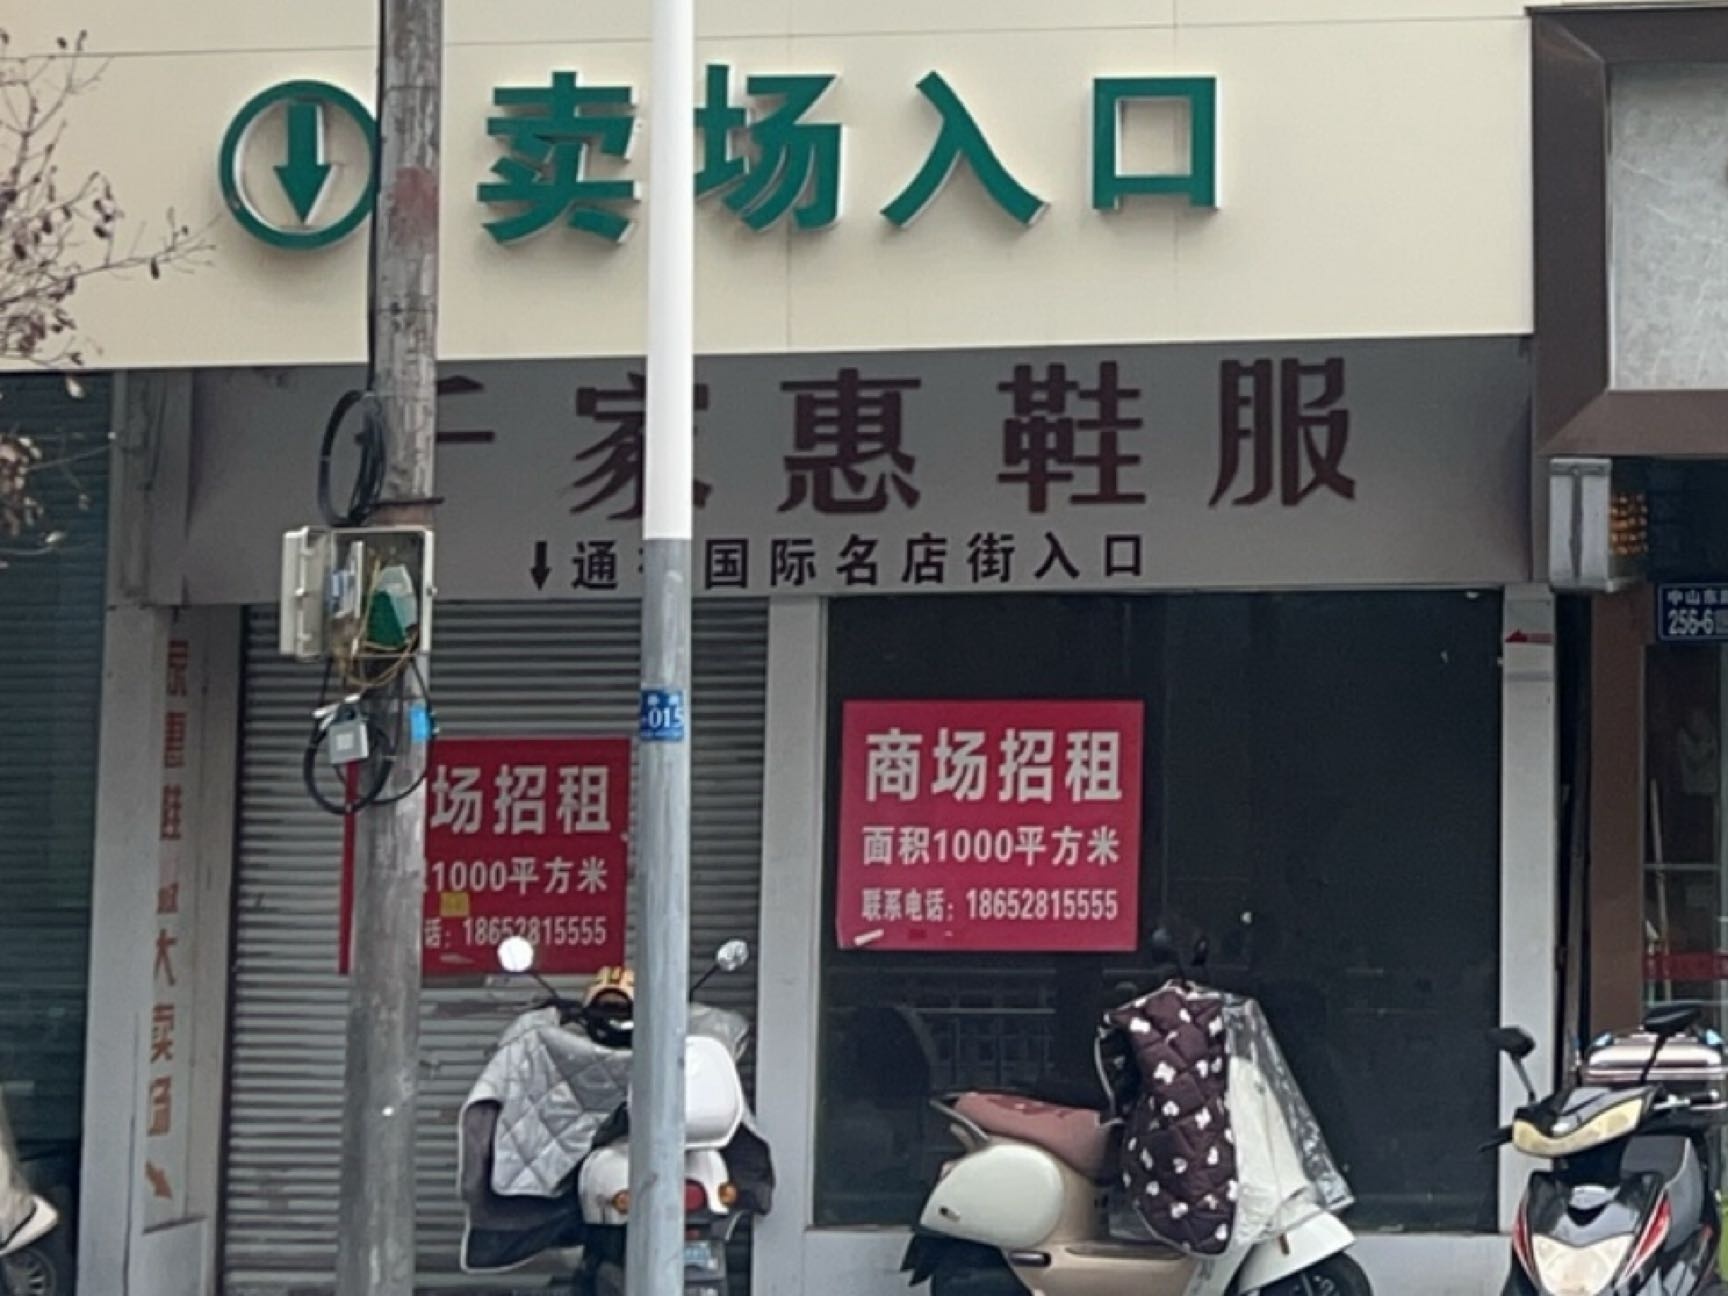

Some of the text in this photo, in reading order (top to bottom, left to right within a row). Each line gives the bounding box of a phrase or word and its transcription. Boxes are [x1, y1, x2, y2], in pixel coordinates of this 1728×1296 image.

[477, 64, 1219, 244] 卖场入口
[571, 530, 1146, 590] 通国际名店街入口
[865, 727, 1122, 802] 商场招租
[424, 856, 607, 894] 1000平方米
[862, 825, 1120, 866] 面积1000平方米
